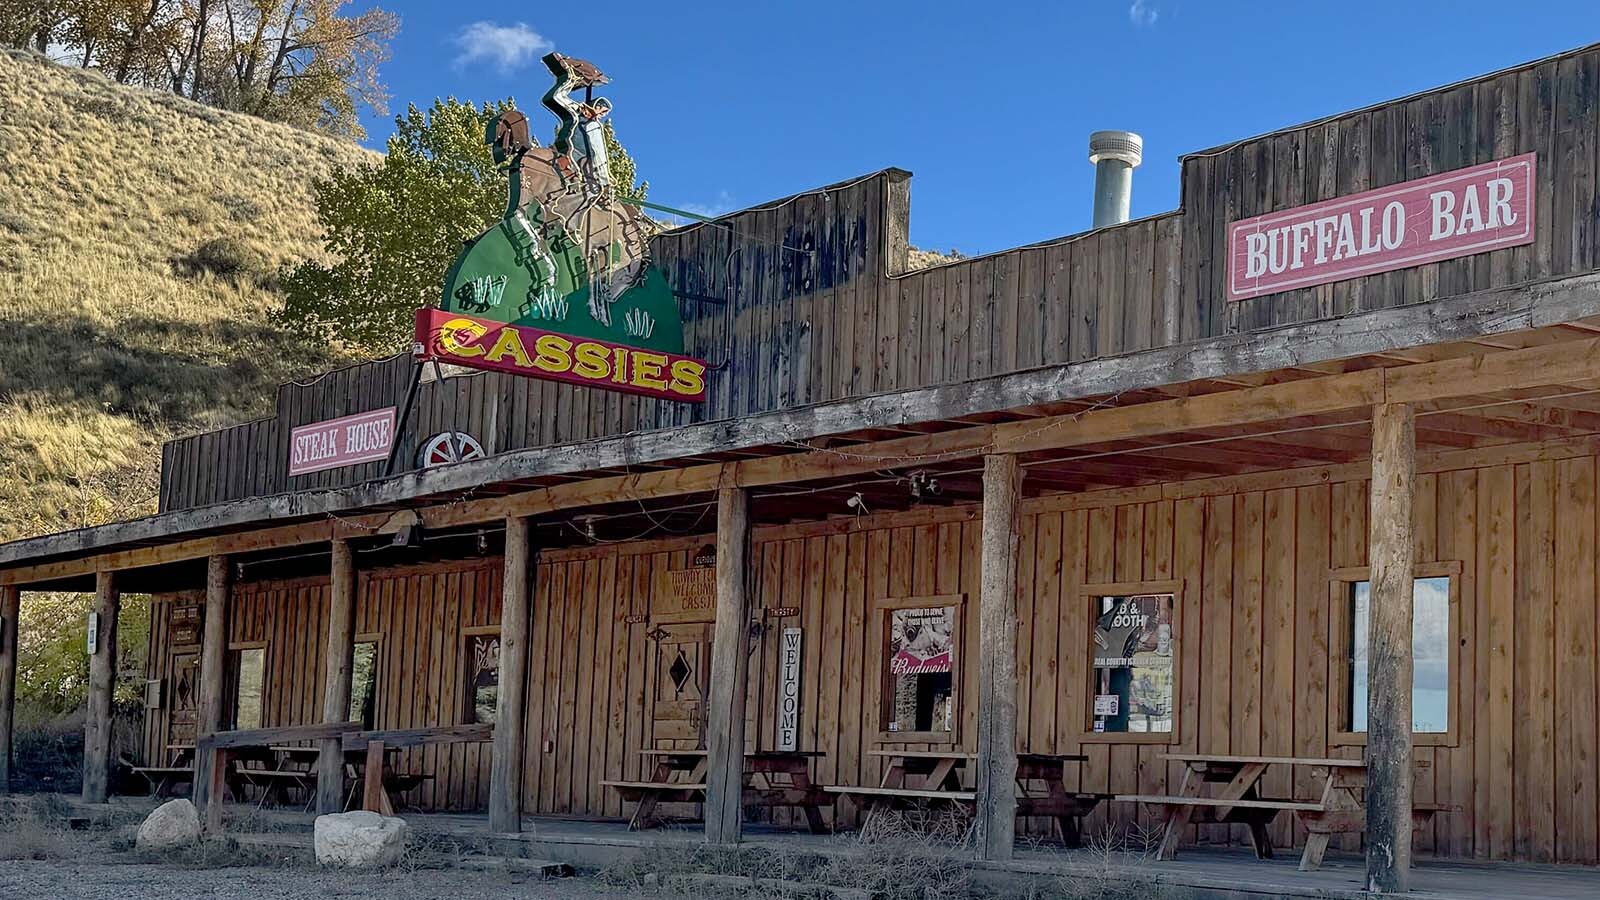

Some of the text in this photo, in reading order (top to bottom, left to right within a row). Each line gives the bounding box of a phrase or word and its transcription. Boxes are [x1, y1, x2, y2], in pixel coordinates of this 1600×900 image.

[1245, 177, 1518, 279] BUFFALO BAR
[441, 318, 706, 395] CASSIES
[294, 418, 390, 465] STEAK HOUSE
[781, 633, 799, 746] WELCOME
